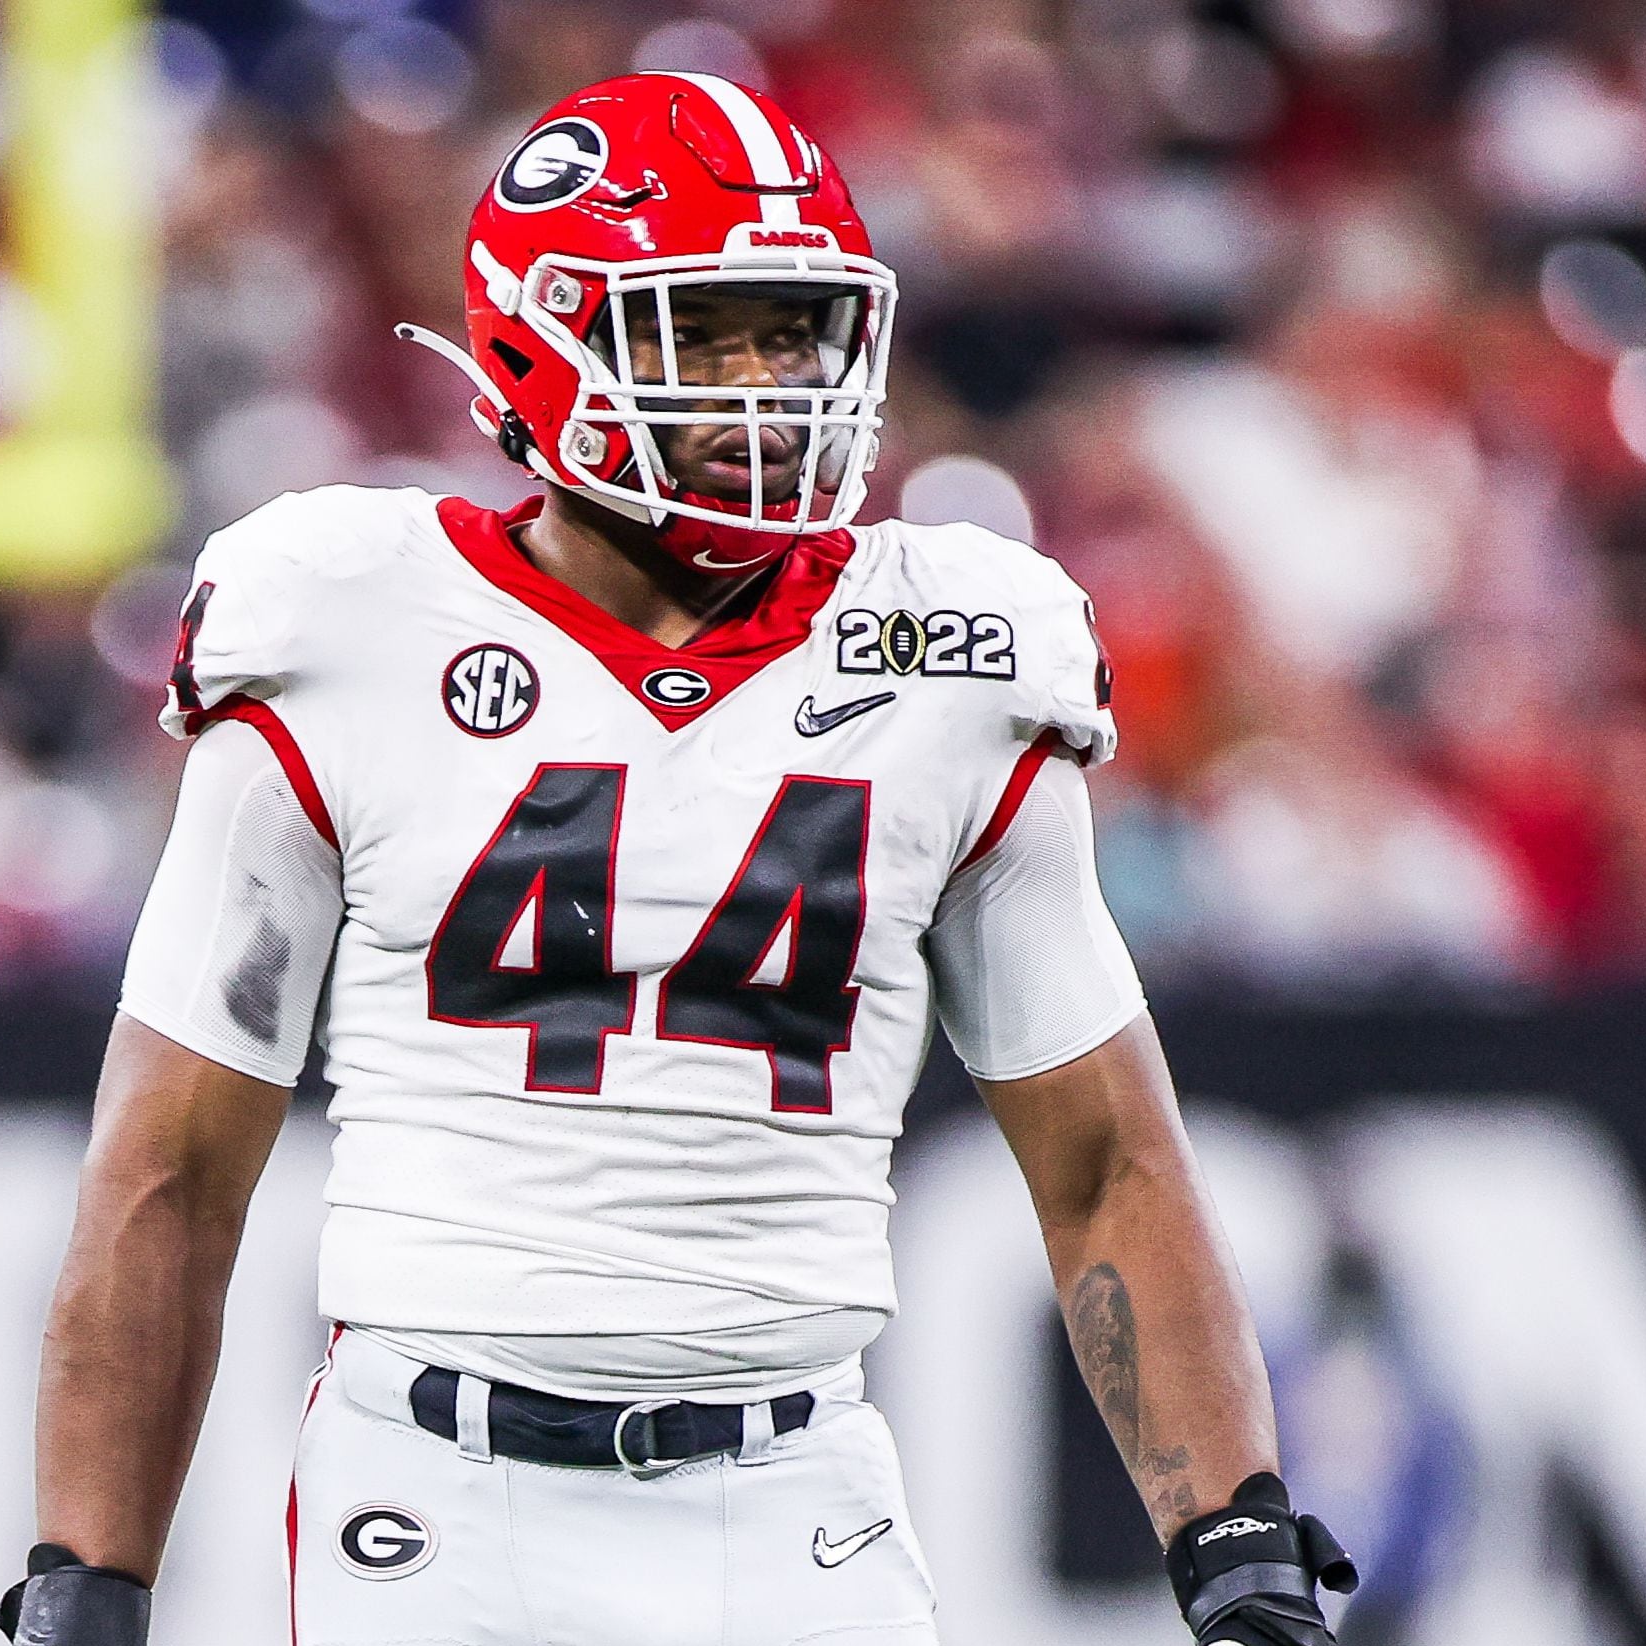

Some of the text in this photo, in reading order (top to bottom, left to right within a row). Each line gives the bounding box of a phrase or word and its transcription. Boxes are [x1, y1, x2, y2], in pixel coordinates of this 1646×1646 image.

[500, 119, 603, 206] G
[836, 608, 1016, 681] 2022
[450, 648, 534, 731] SEC
[644, 670, 709, 705] G
[425, 762, 871, 1115] 44
[339, 1509, 427, 1569] G
